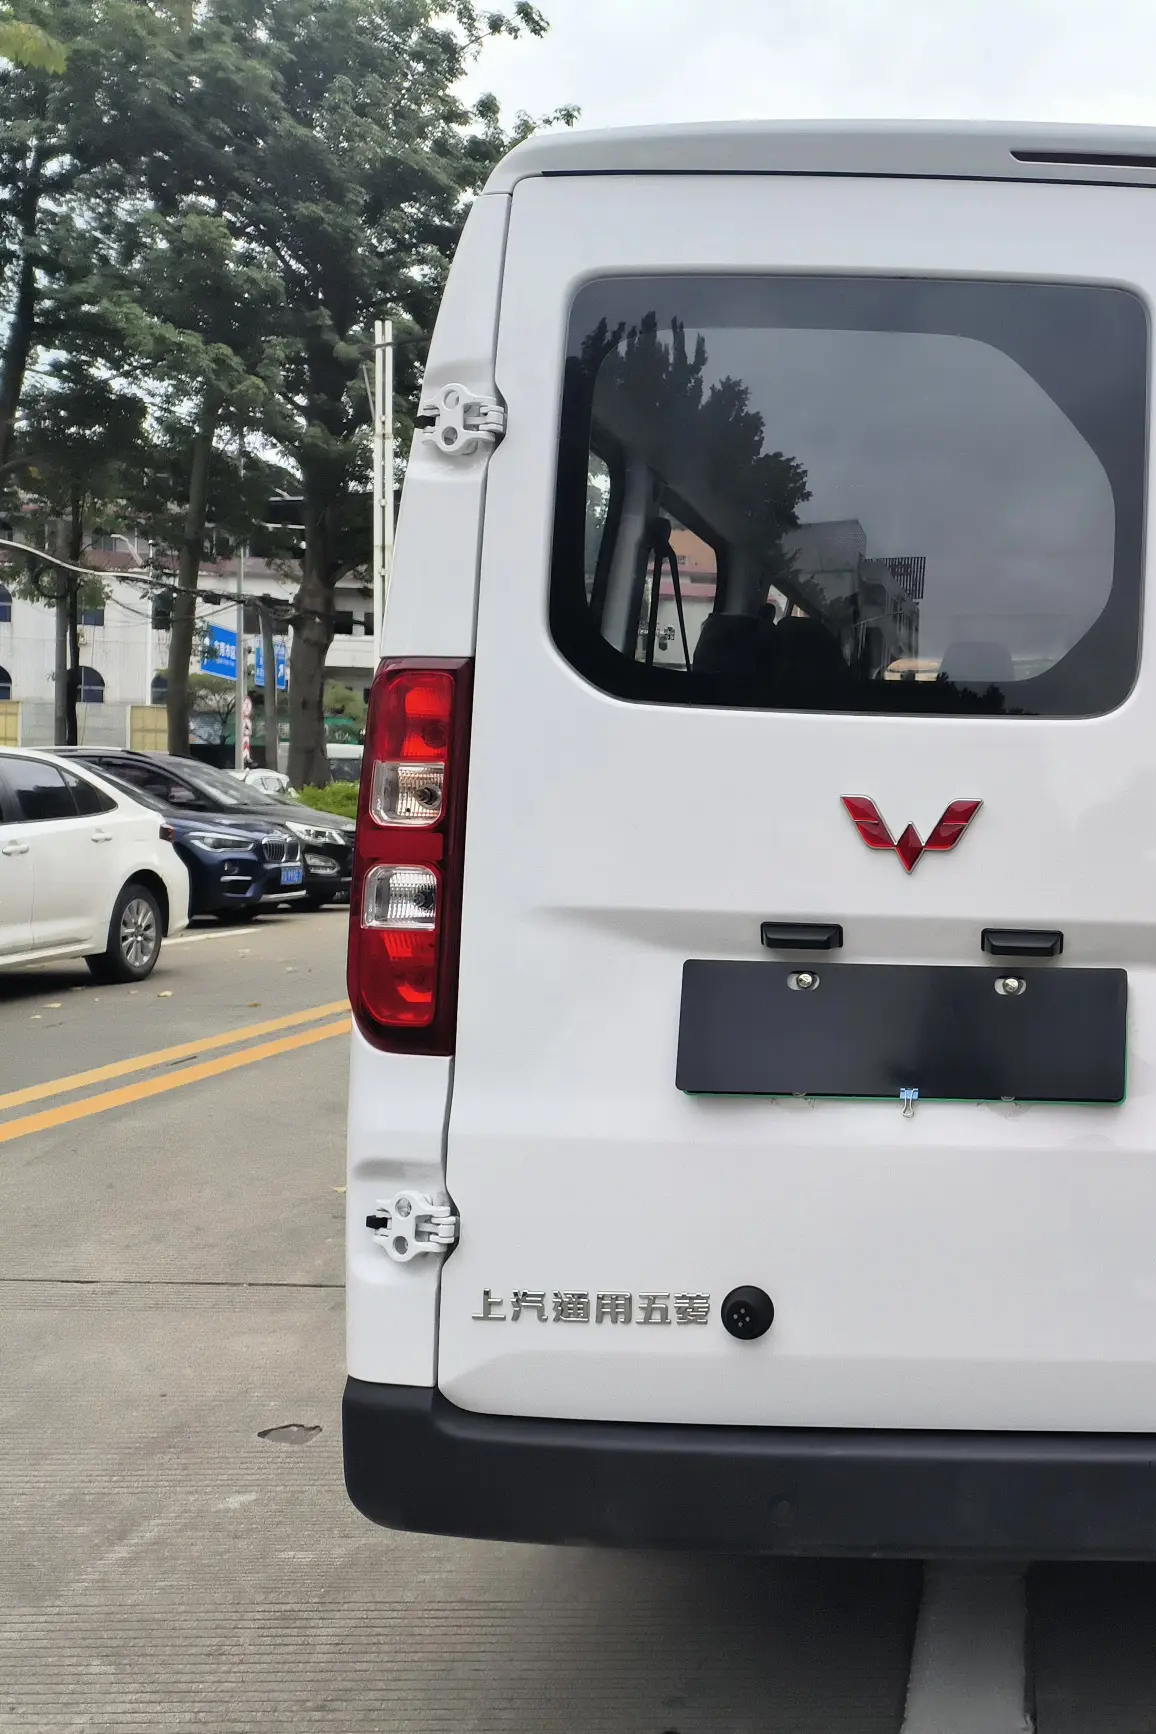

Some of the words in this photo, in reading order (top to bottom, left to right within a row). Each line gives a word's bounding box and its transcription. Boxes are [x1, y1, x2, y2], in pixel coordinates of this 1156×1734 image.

[471, 1287, 711, 1326] 上汽通用五菱
